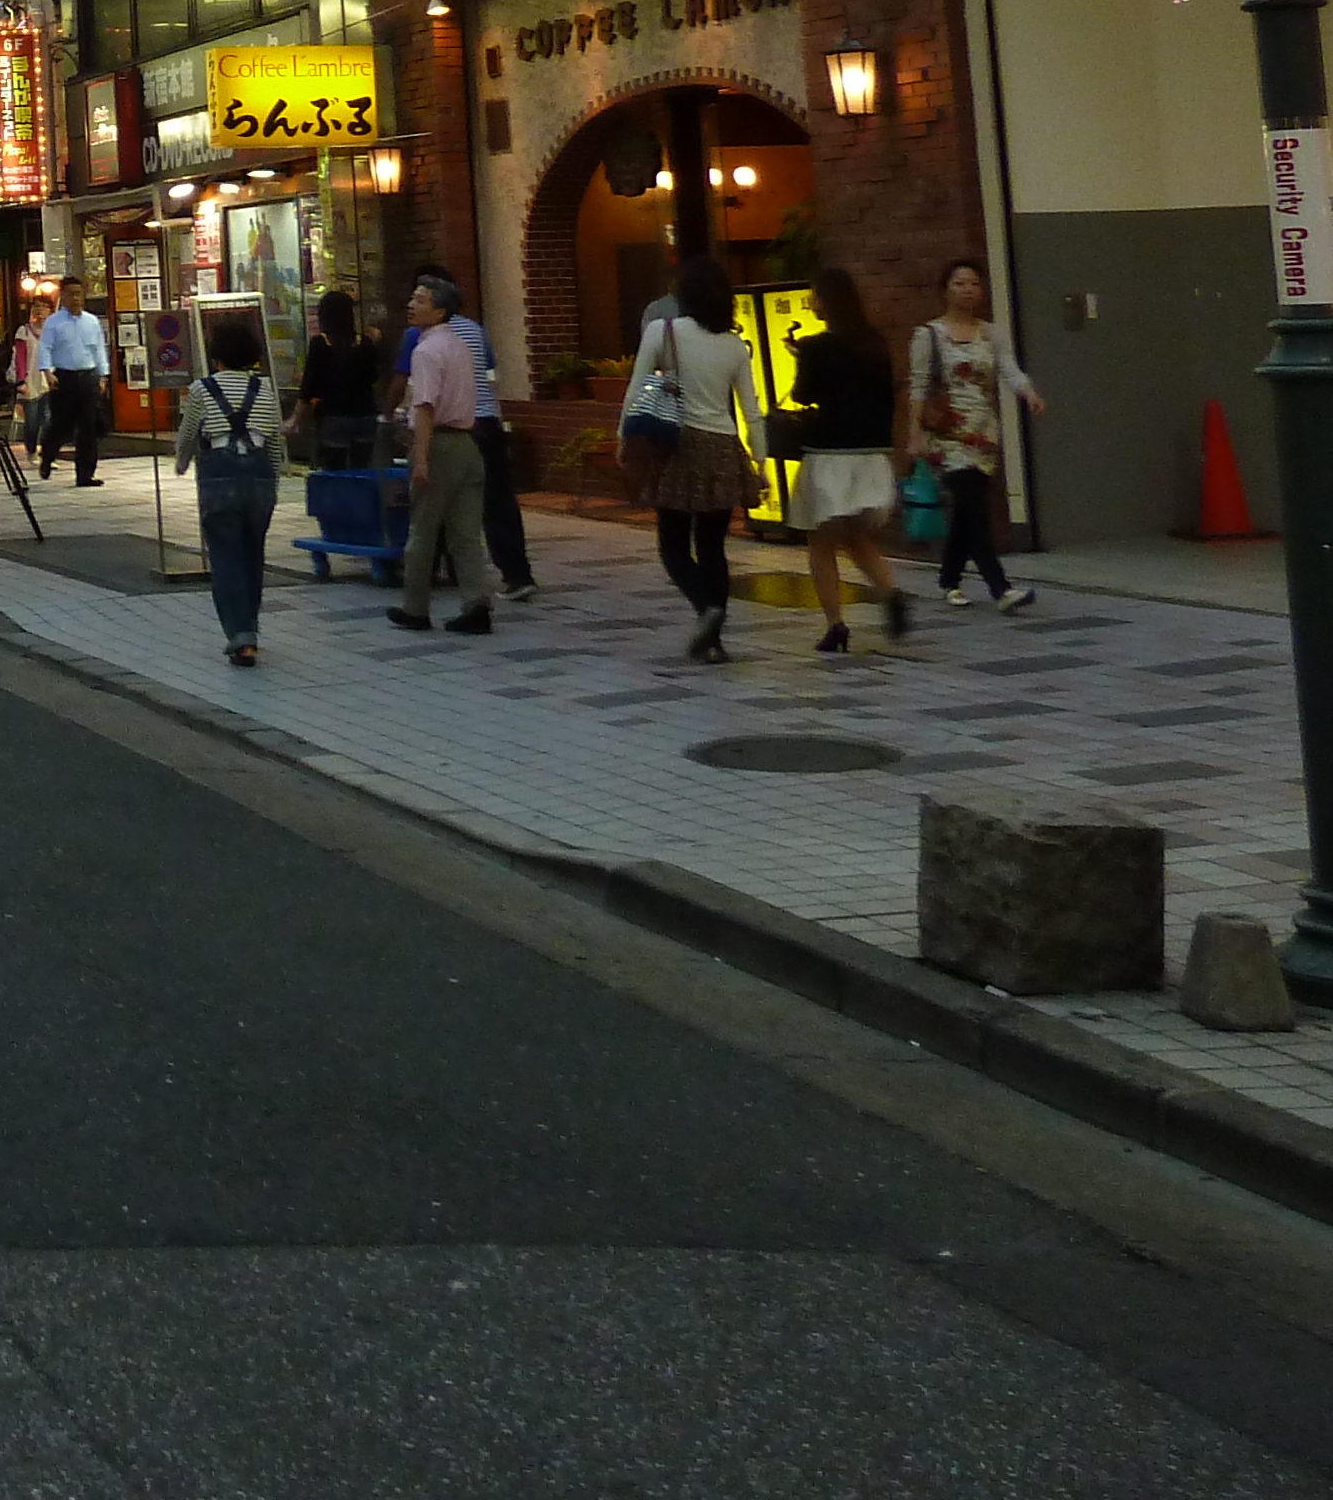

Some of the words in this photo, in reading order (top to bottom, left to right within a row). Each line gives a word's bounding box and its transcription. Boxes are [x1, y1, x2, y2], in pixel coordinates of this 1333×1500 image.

[3, 37, 24, 52] 6F
[218, 54, 289, 79] Coffee
[292, 53, 373, 78] L'ambre
[12, 55, 33, 142] まんが喫茶
[221, 96, 373, 139] らんぶる
[1271, 137, 1305, 217] Security
[1280, 226, 1309, 298] Camera
